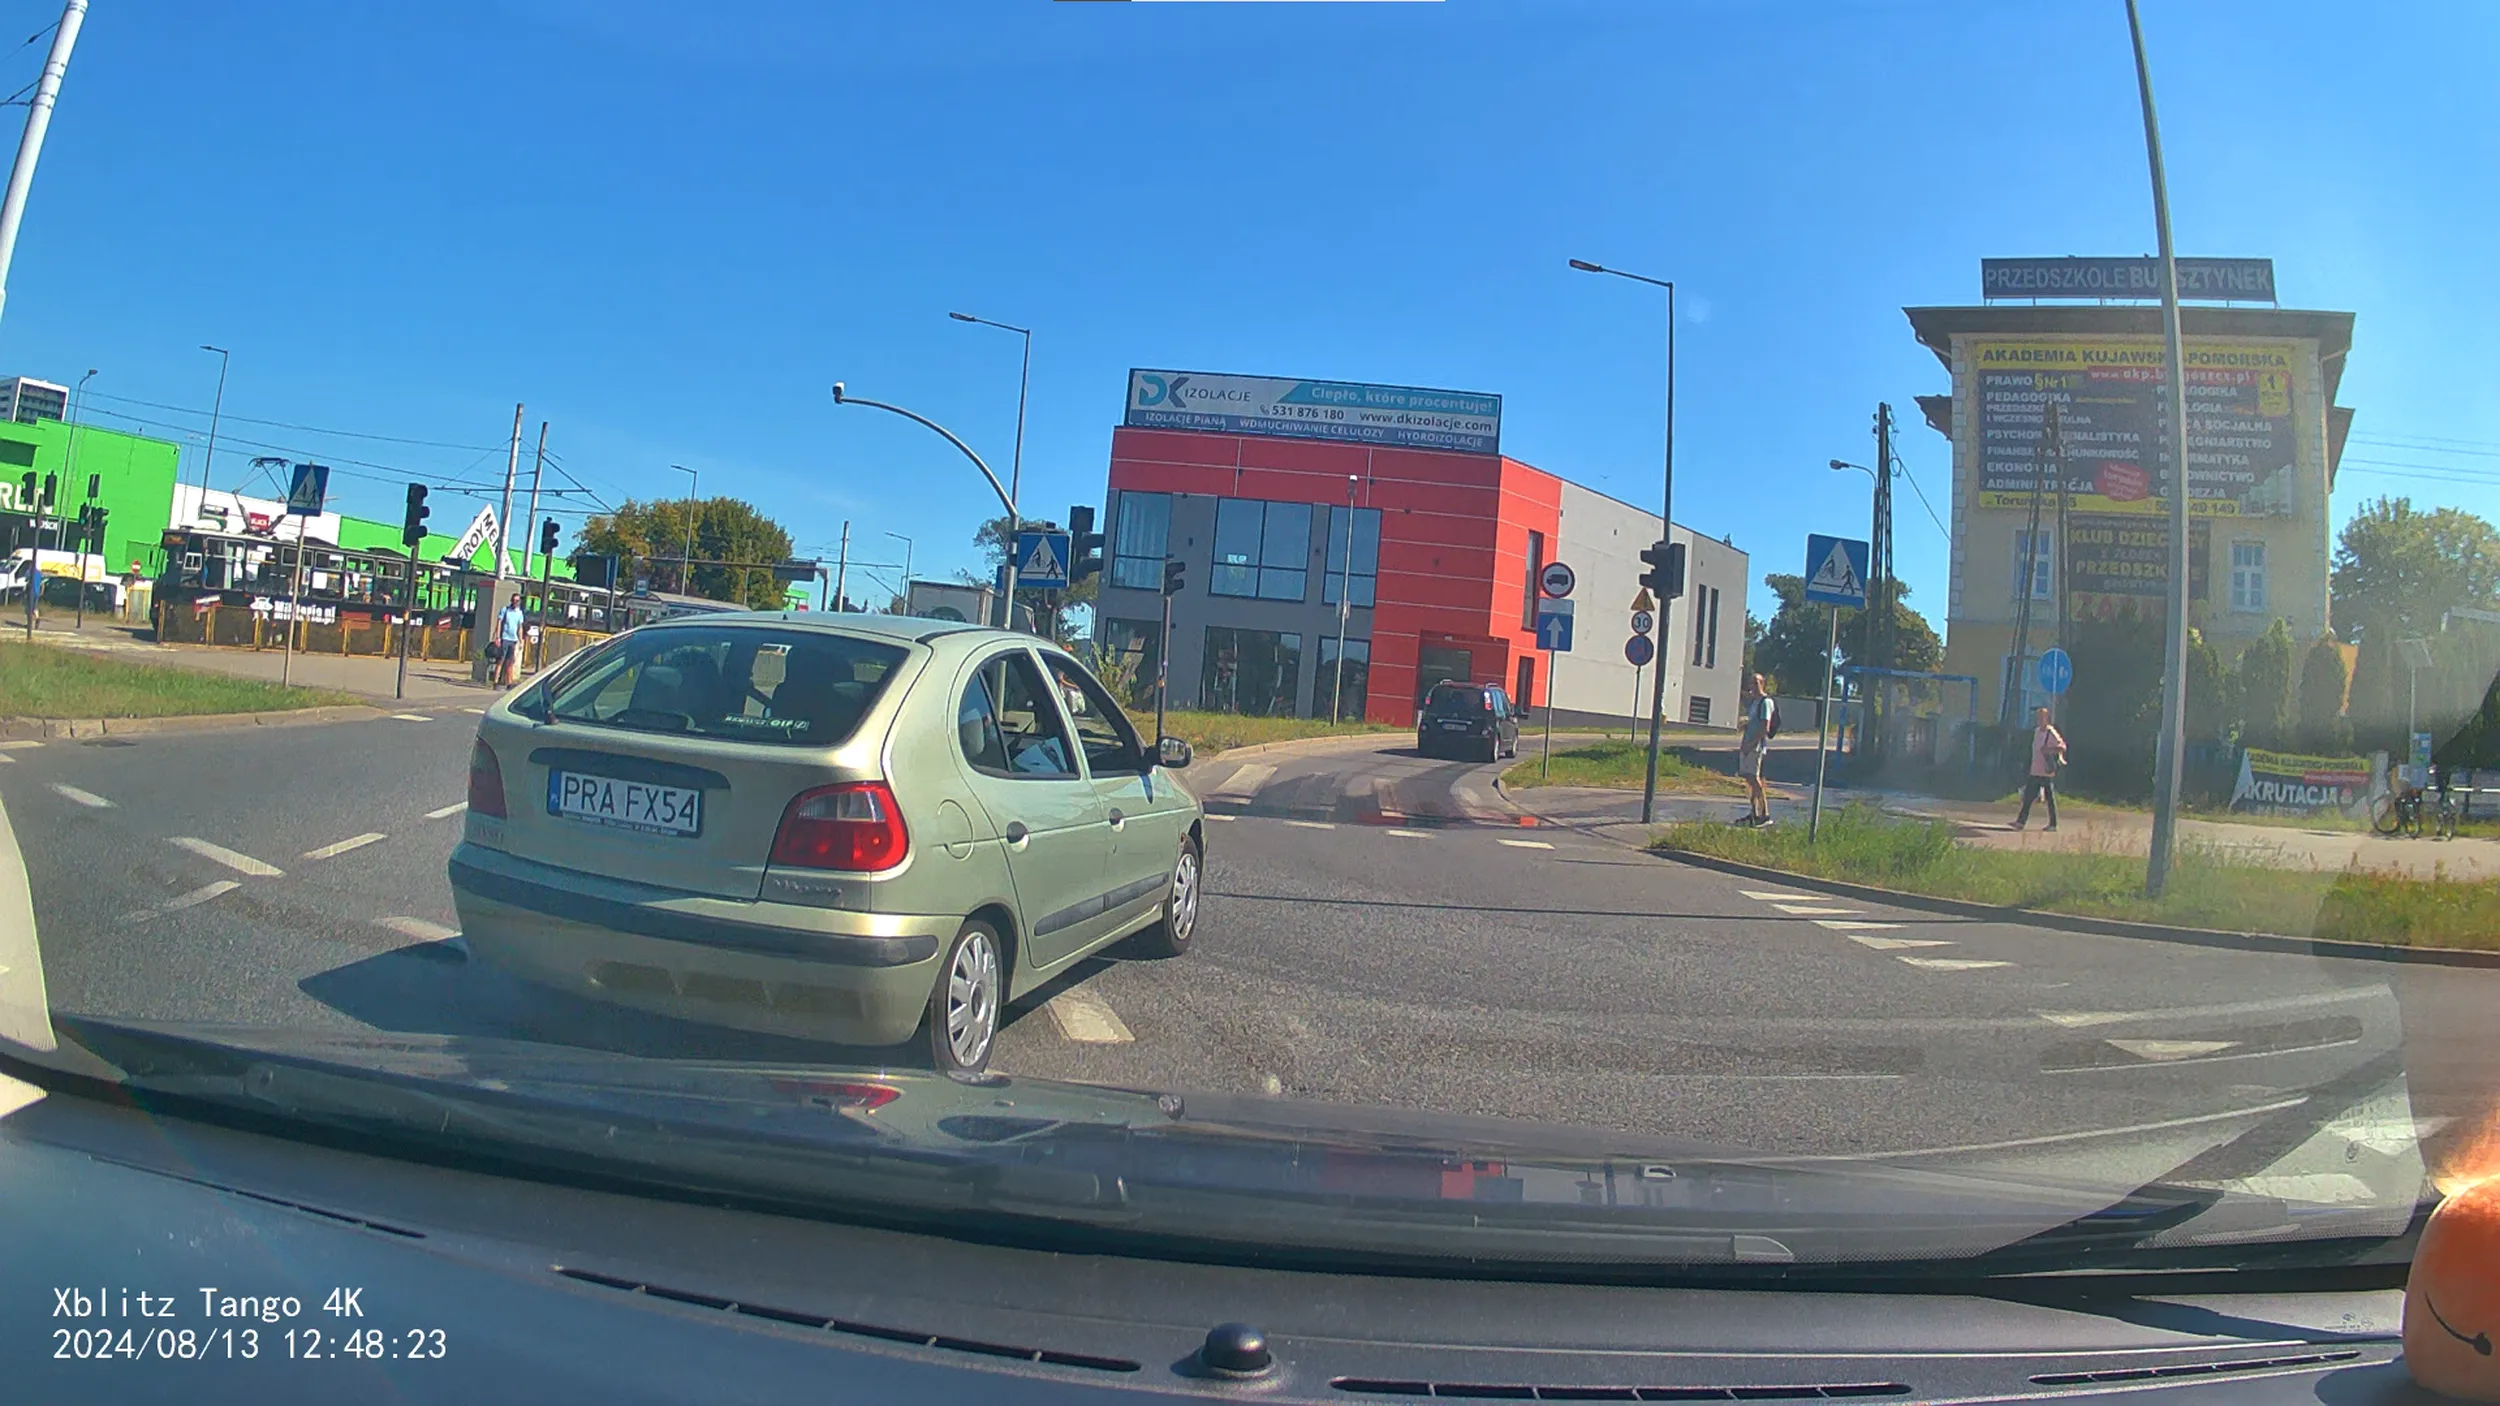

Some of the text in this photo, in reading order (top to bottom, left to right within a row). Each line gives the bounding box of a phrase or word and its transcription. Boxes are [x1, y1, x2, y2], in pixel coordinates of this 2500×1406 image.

[1985, 266, 2272, 291] PRZEDSZKOLE BUSZTYNEK
[1983, 349, 2286, 367] AKADEMIA KUJAWSK POMORSKA
[1986, 375, 2033, 386] PRAWO
[1185, 388, 1251, 402] IZOLACJE
[1311, 387, 1493, 414] Ciepło, które procentuje!
[1145, 411, 1483, 447] IZOLACJE PIANĄ WDMUCHIWANIE CELULOZY HYDROIZOLACJE
[1272, 405, 1492, 432] 531 876 180 www.dkizolacje.com
[1986, 462, 2058, 473] EKONOIA
[2076, 560, 2200, 581] PRZEDSZKE
[1635, 617, 1649, 628] 30
[563, 776, 615, 815] PRA
[625, 785, 696, 827] FX54
[2244, 780, 2338, 805] KRUTACJA
